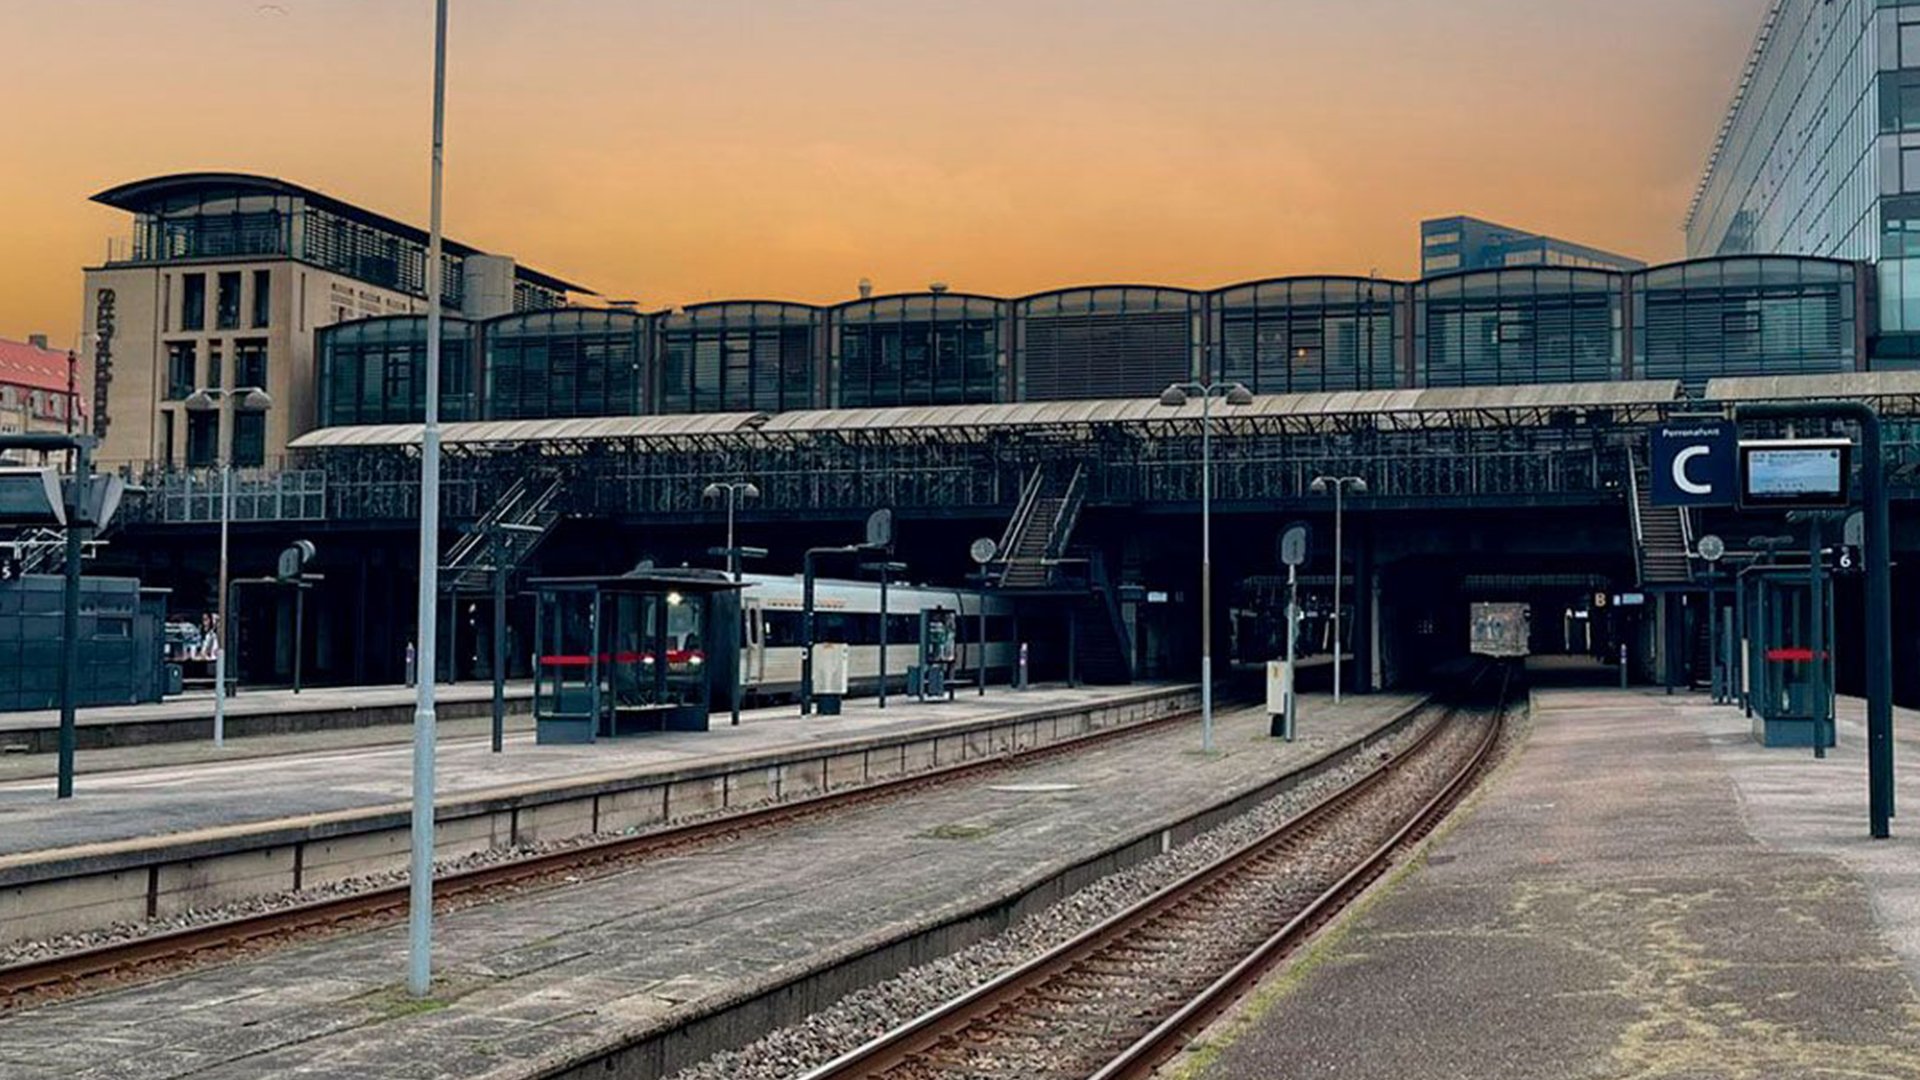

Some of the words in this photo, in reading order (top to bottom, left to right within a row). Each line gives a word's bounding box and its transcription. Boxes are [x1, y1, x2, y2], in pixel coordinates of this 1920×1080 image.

[1672, 445, 1712, 494] C
[1840, 553, 1851, 568] 6
[2, 566, 11, 579] 5
[1595, 593, 1606, 607] B
